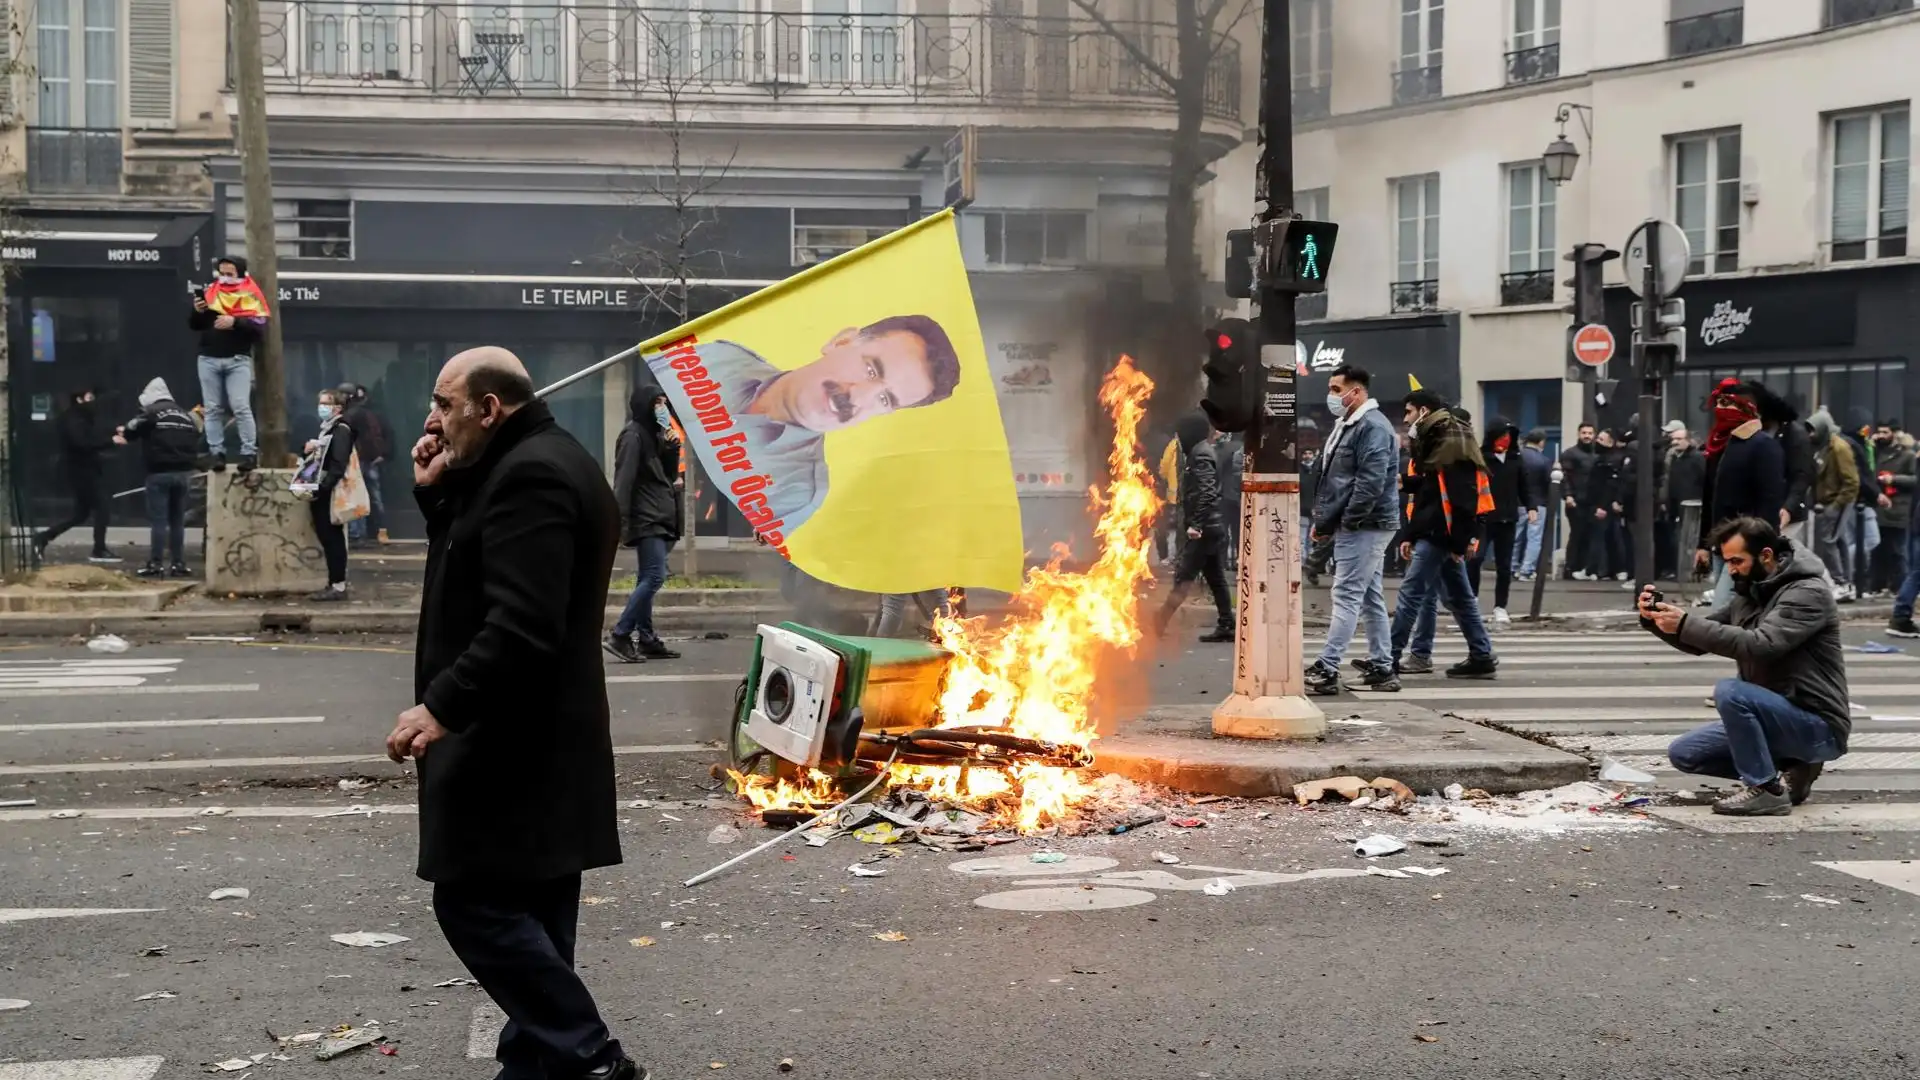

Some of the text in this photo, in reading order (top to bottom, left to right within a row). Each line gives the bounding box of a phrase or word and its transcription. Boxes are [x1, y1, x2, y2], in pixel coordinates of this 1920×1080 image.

[107, 249, 160, 262] HOT DOG
[293, 287, 321, 301] Thé
[521, 288, 628, 306] LE TEMPLE
[657, 333, 736, 434] Freedom
[709, 432, 754, 473] For
